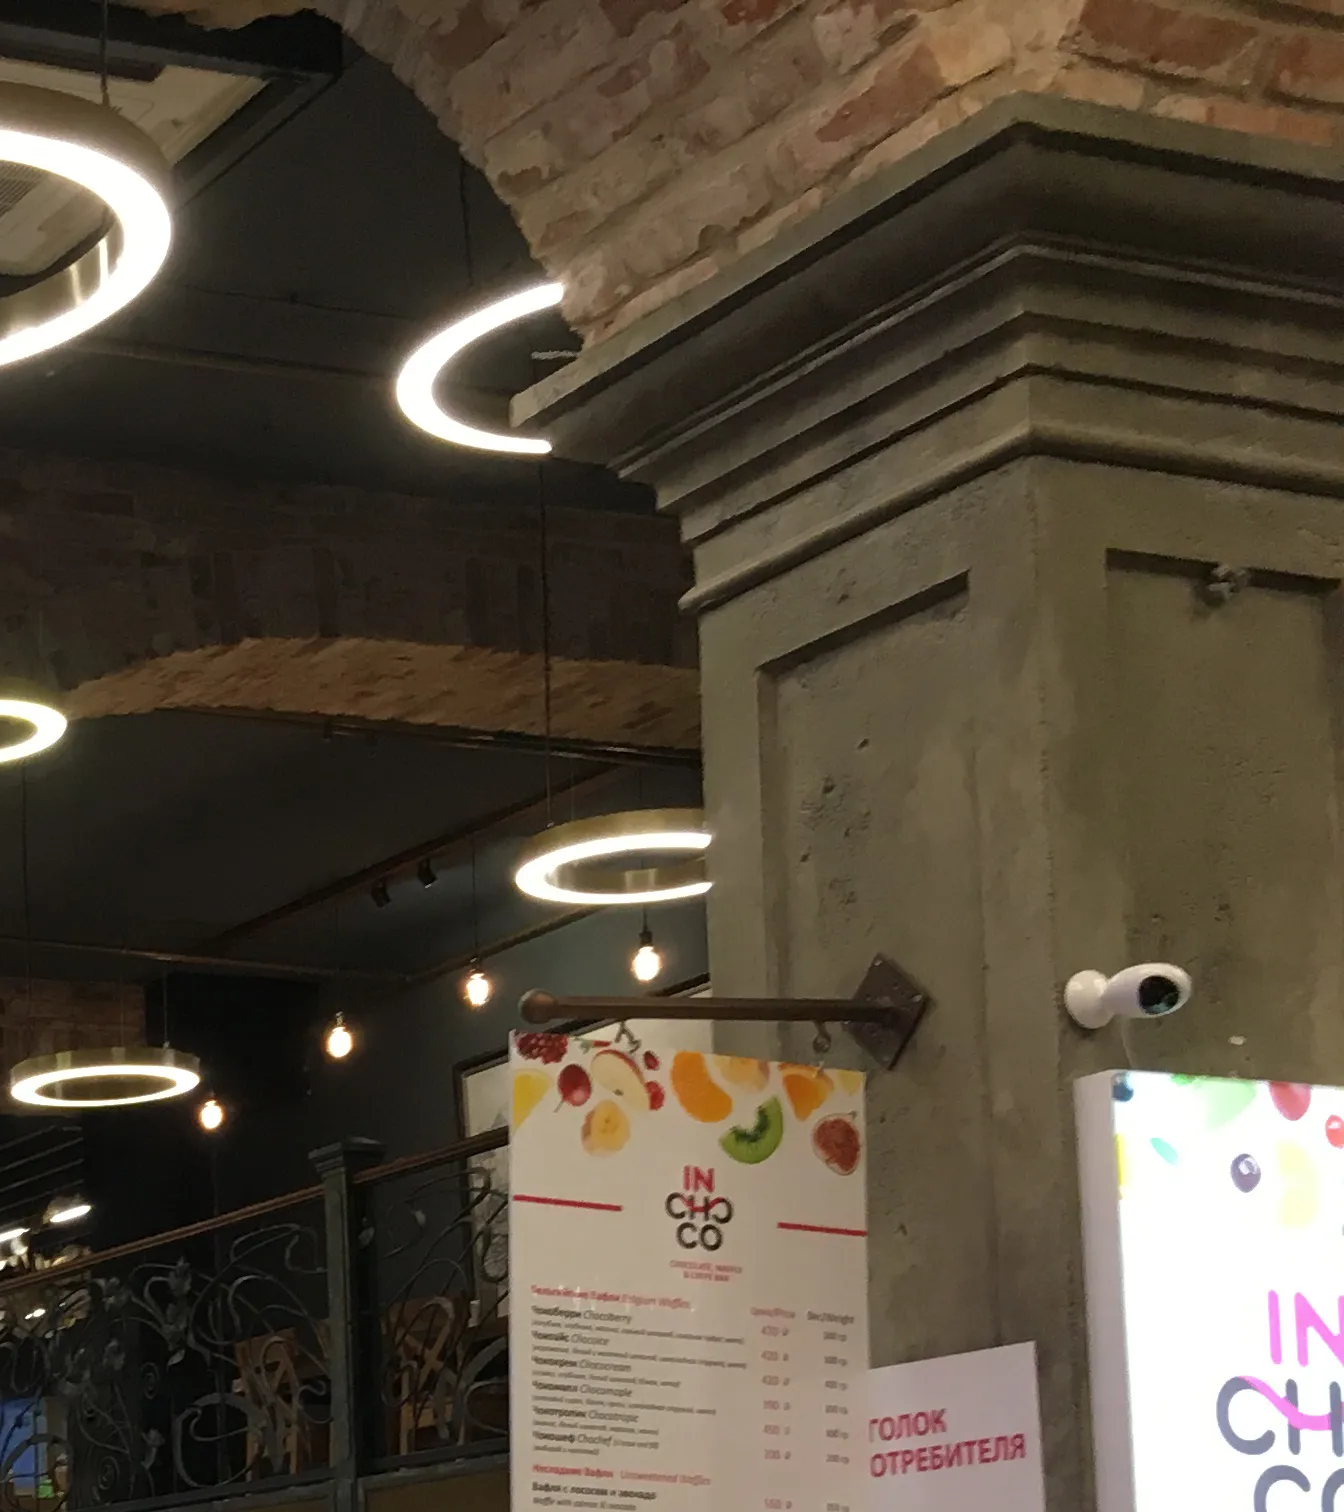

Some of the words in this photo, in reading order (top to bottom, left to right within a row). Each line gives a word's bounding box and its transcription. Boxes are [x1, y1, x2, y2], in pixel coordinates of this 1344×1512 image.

[683, 1165, 715, 1192] IN
[676, 1222, 723, 1251] CO
[1268, 1290, 1344, 1367] IN
[1216, 1375, 1344, 1457] CH
[870, 1433, 1026, 1477] ОТРЕБИТЕЛЯ
